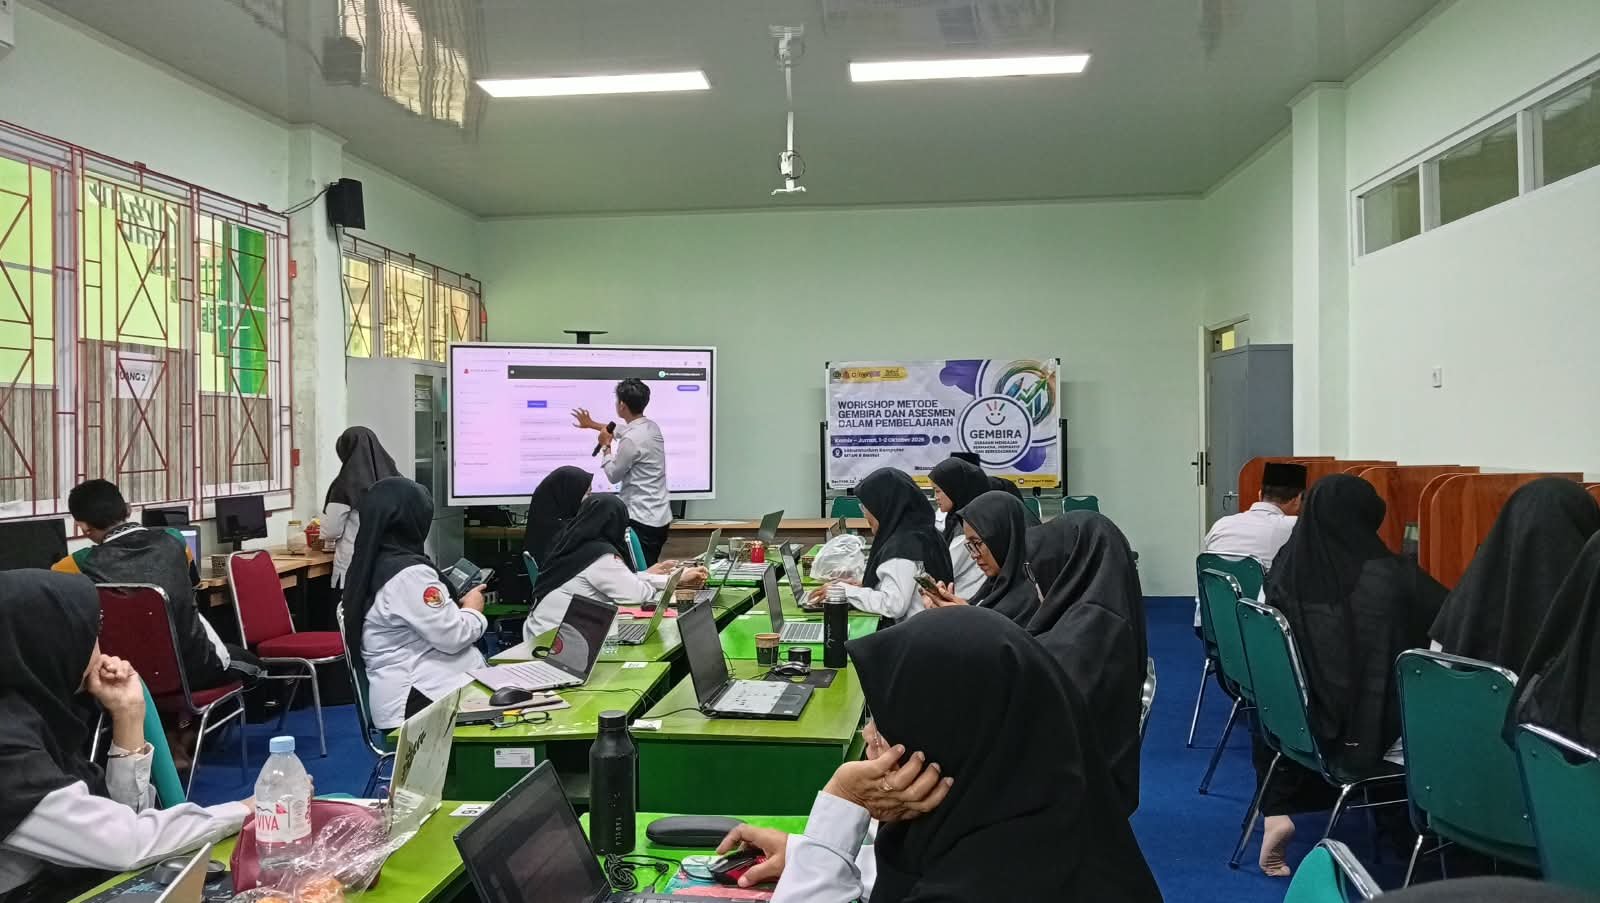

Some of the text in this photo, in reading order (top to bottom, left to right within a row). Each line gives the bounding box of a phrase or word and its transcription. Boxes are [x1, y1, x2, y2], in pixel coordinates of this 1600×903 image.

[141, 373, 147, 381] 2
[837, 400, 939, 409] WORKSHOP METODE
[837, 408, 956, 419] GEMBIRA DAN ASESMEN
[838, 418, 954, 428] DALAM PEMBELAJARAN
[970, 430, 1022, 439] GEMBIRA
[256, 815, 279, 831] VIVA
